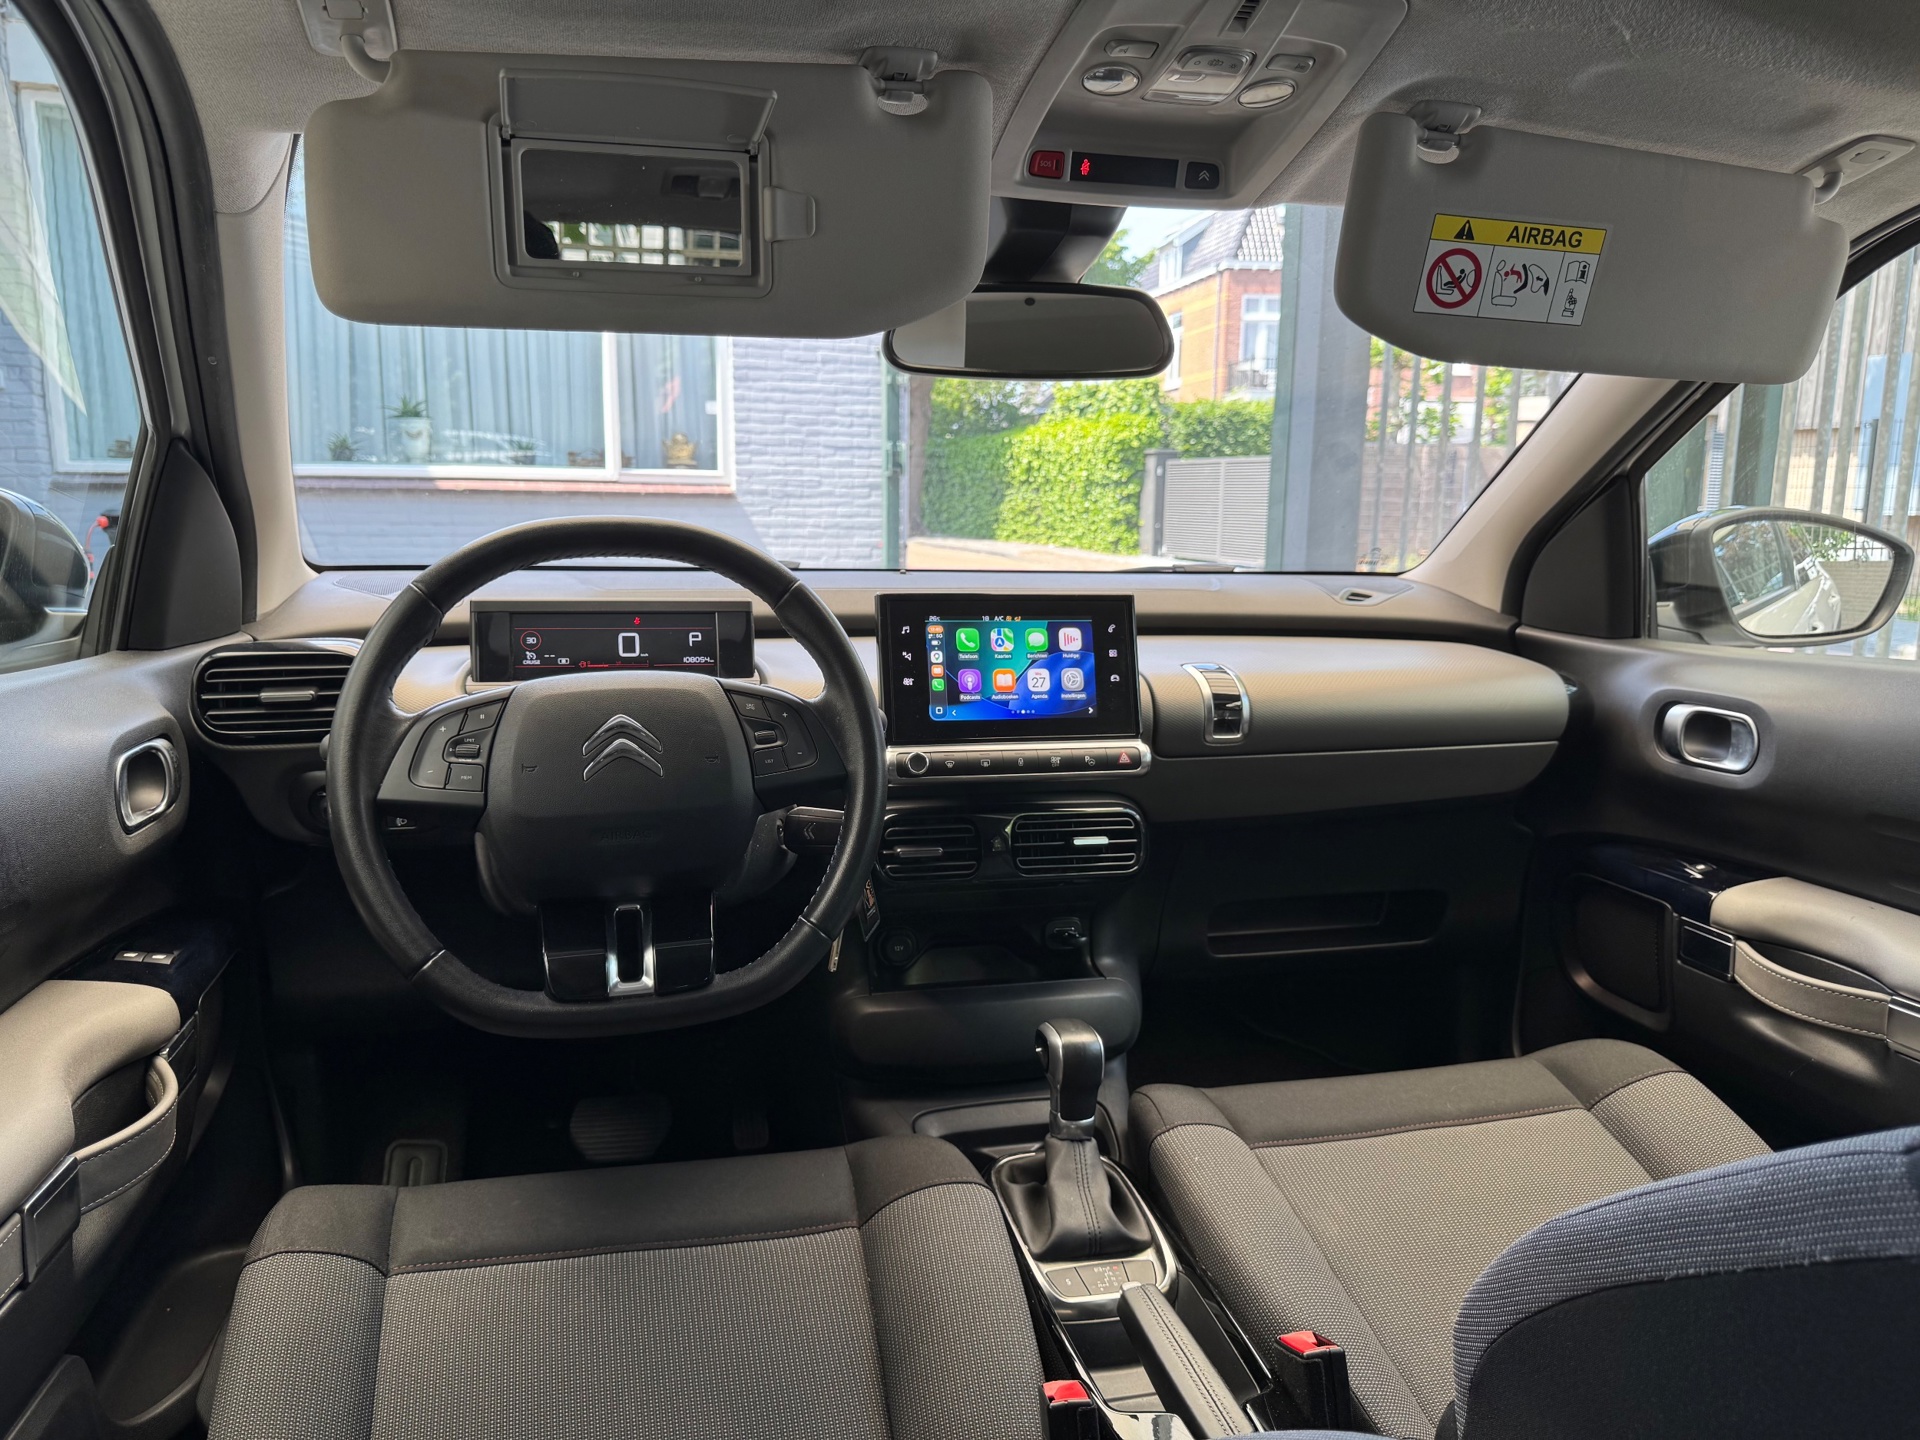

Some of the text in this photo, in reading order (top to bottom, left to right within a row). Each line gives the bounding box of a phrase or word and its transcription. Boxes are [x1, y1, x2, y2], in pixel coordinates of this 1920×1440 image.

[1506, 225, 1583, 248] AIRBAG
[617, 632, 640, 658] 0
[688, 632, 702, 647] P
[1031, 676, 1046, 688] 27
[894, 944, 904, 952] 12V
